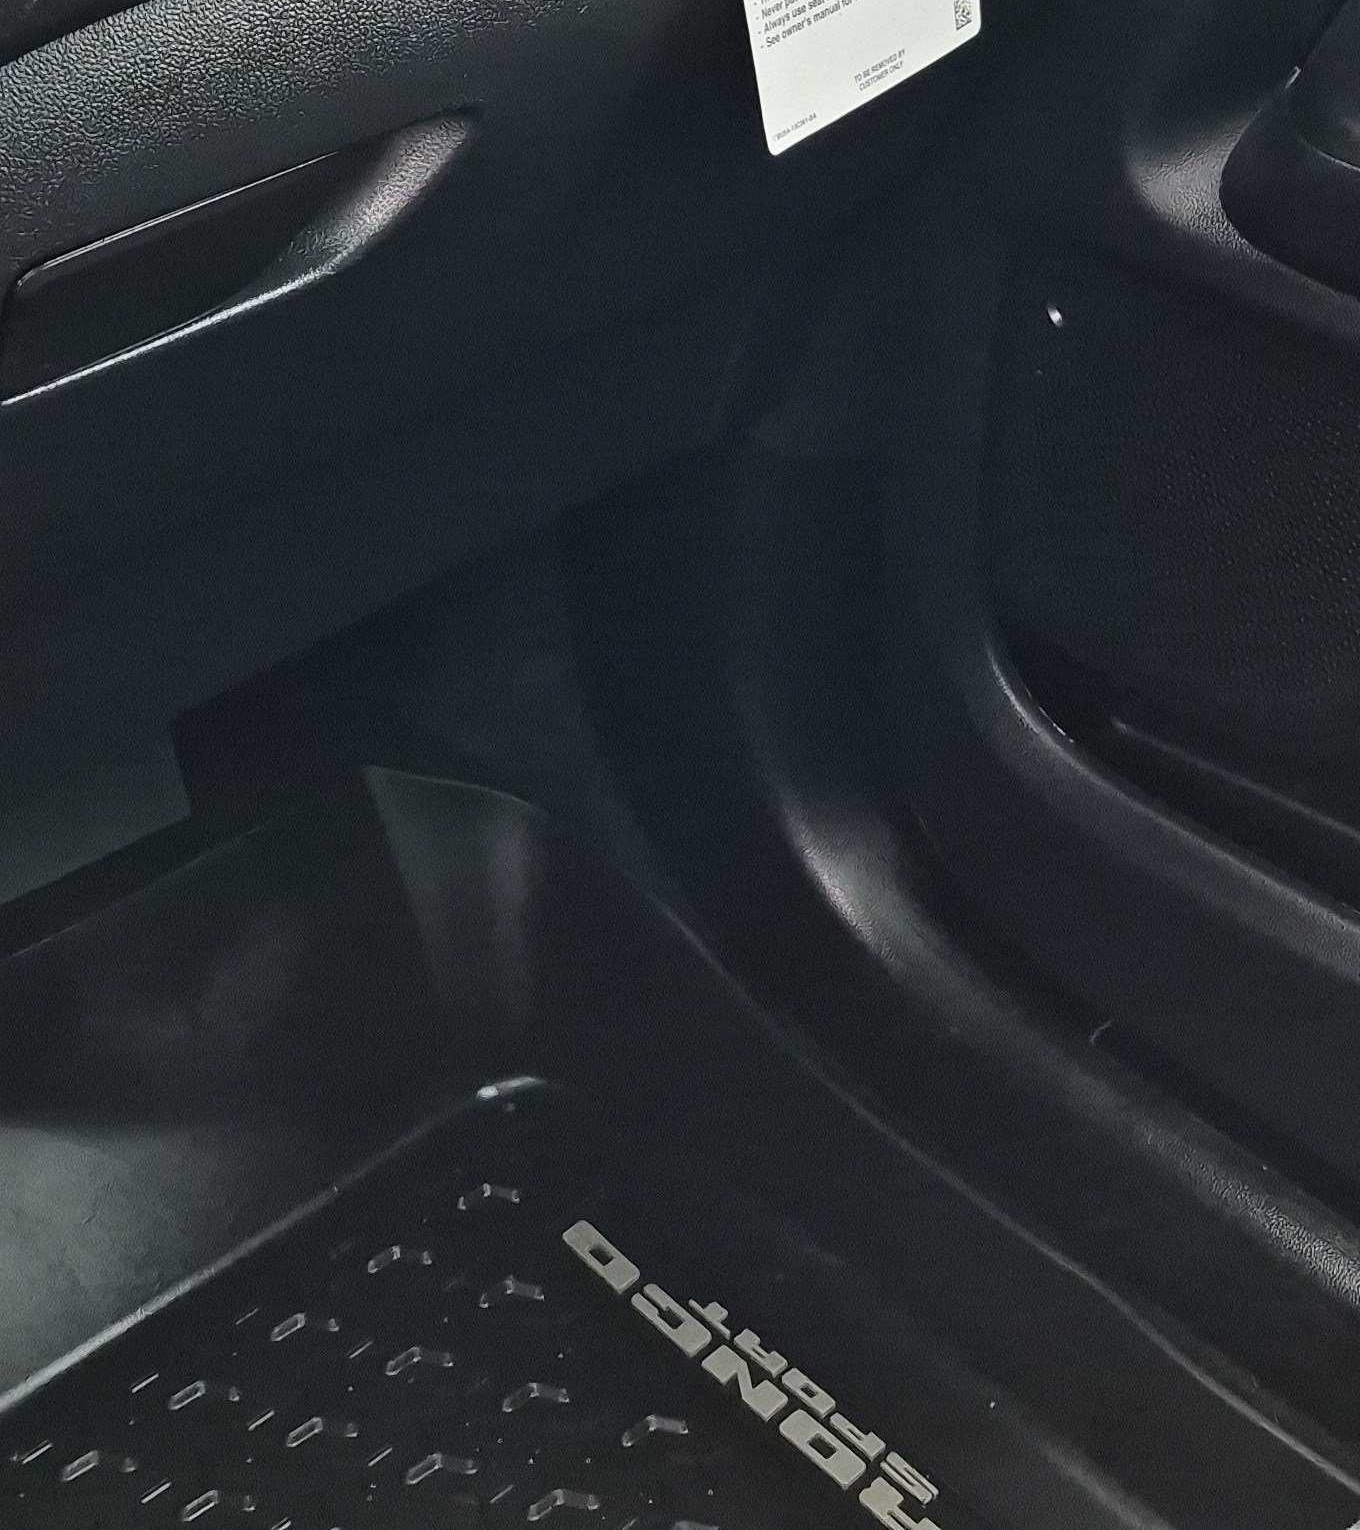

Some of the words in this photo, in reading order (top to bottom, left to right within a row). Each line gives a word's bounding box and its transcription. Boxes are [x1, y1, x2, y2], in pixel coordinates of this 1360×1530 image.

[761, 1, 783, 19] Never
[764, 13, 790, 34] Always
[791, 5, 806, 18] use
[766, 34, 780, 48] See
[781, 17, 812, 39] owner's
[813, 1, 841, 22] manual
[688, 1299, 939, 1505] SPORT
